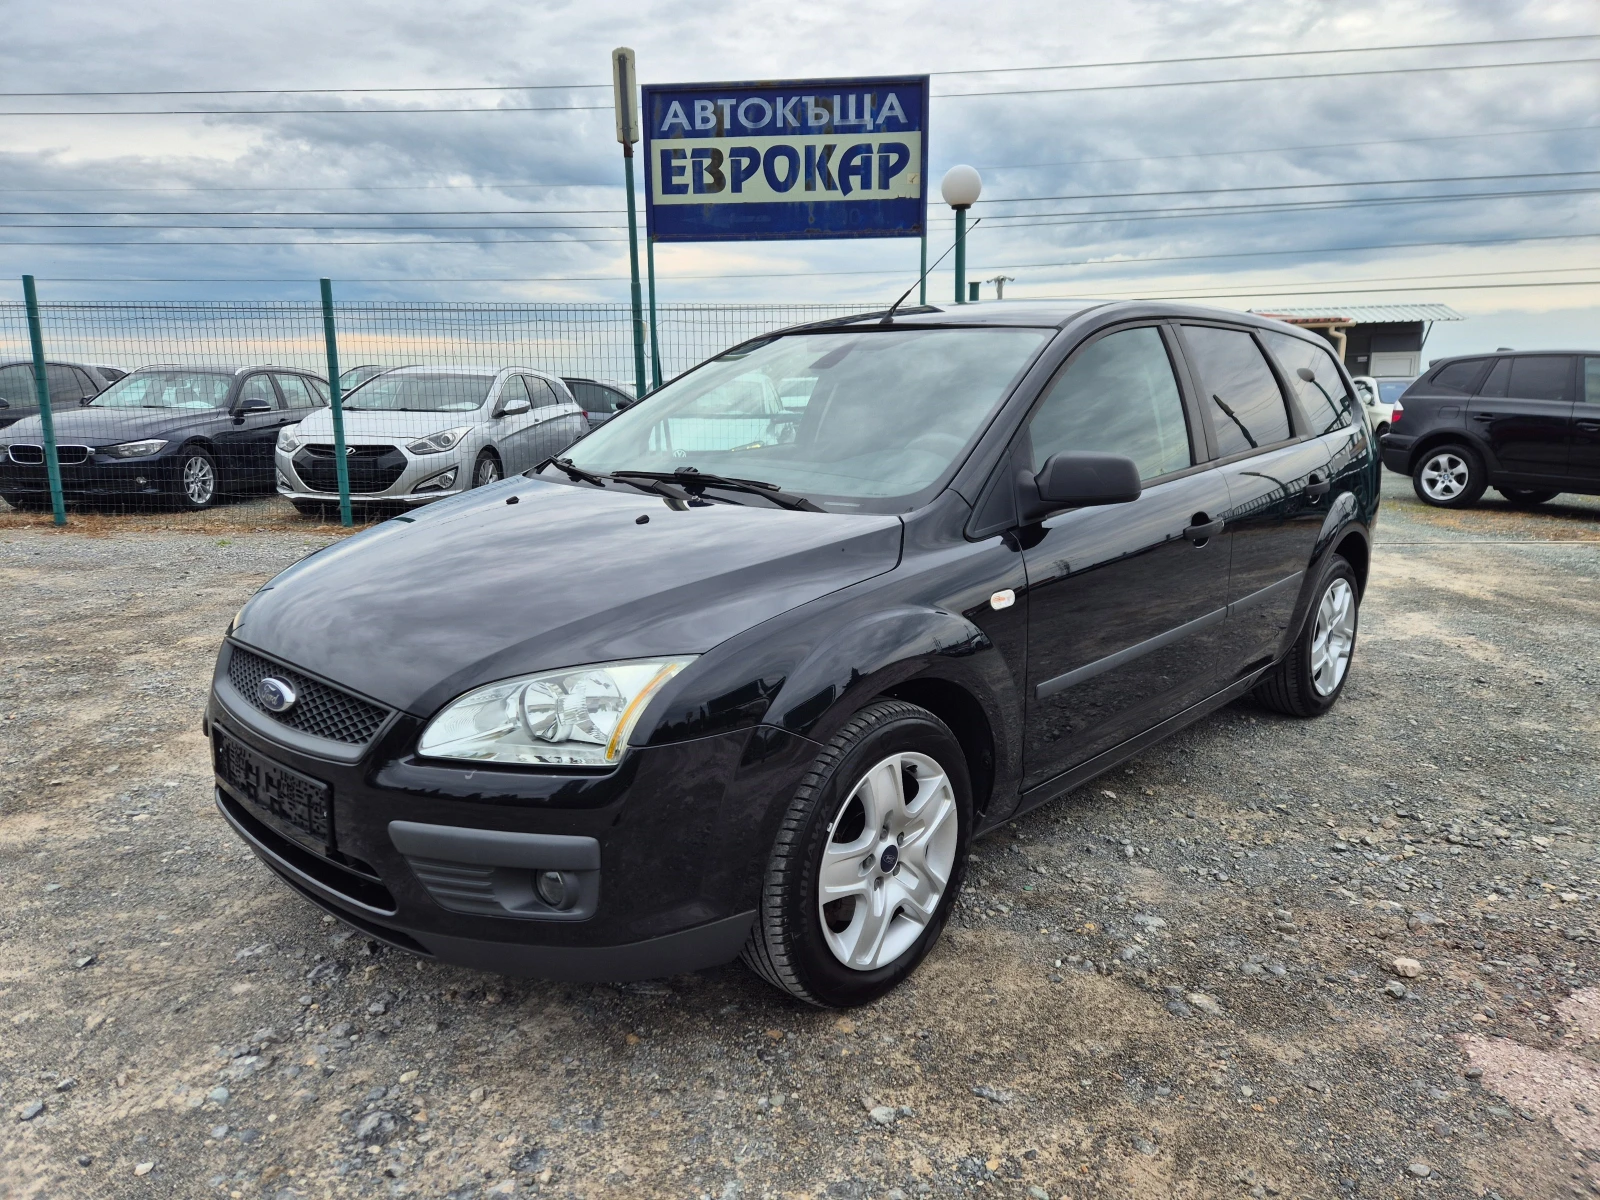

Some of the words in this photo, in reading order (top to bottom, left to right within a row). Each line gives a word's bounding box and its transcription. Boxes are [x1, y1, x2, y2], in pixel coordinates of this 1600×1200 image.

[661, 92, 908, 131] АВТОКЪЩА
[661, 142, 910, 197] ЕВРОКАР
[262, 684, 280, 706] Ford
